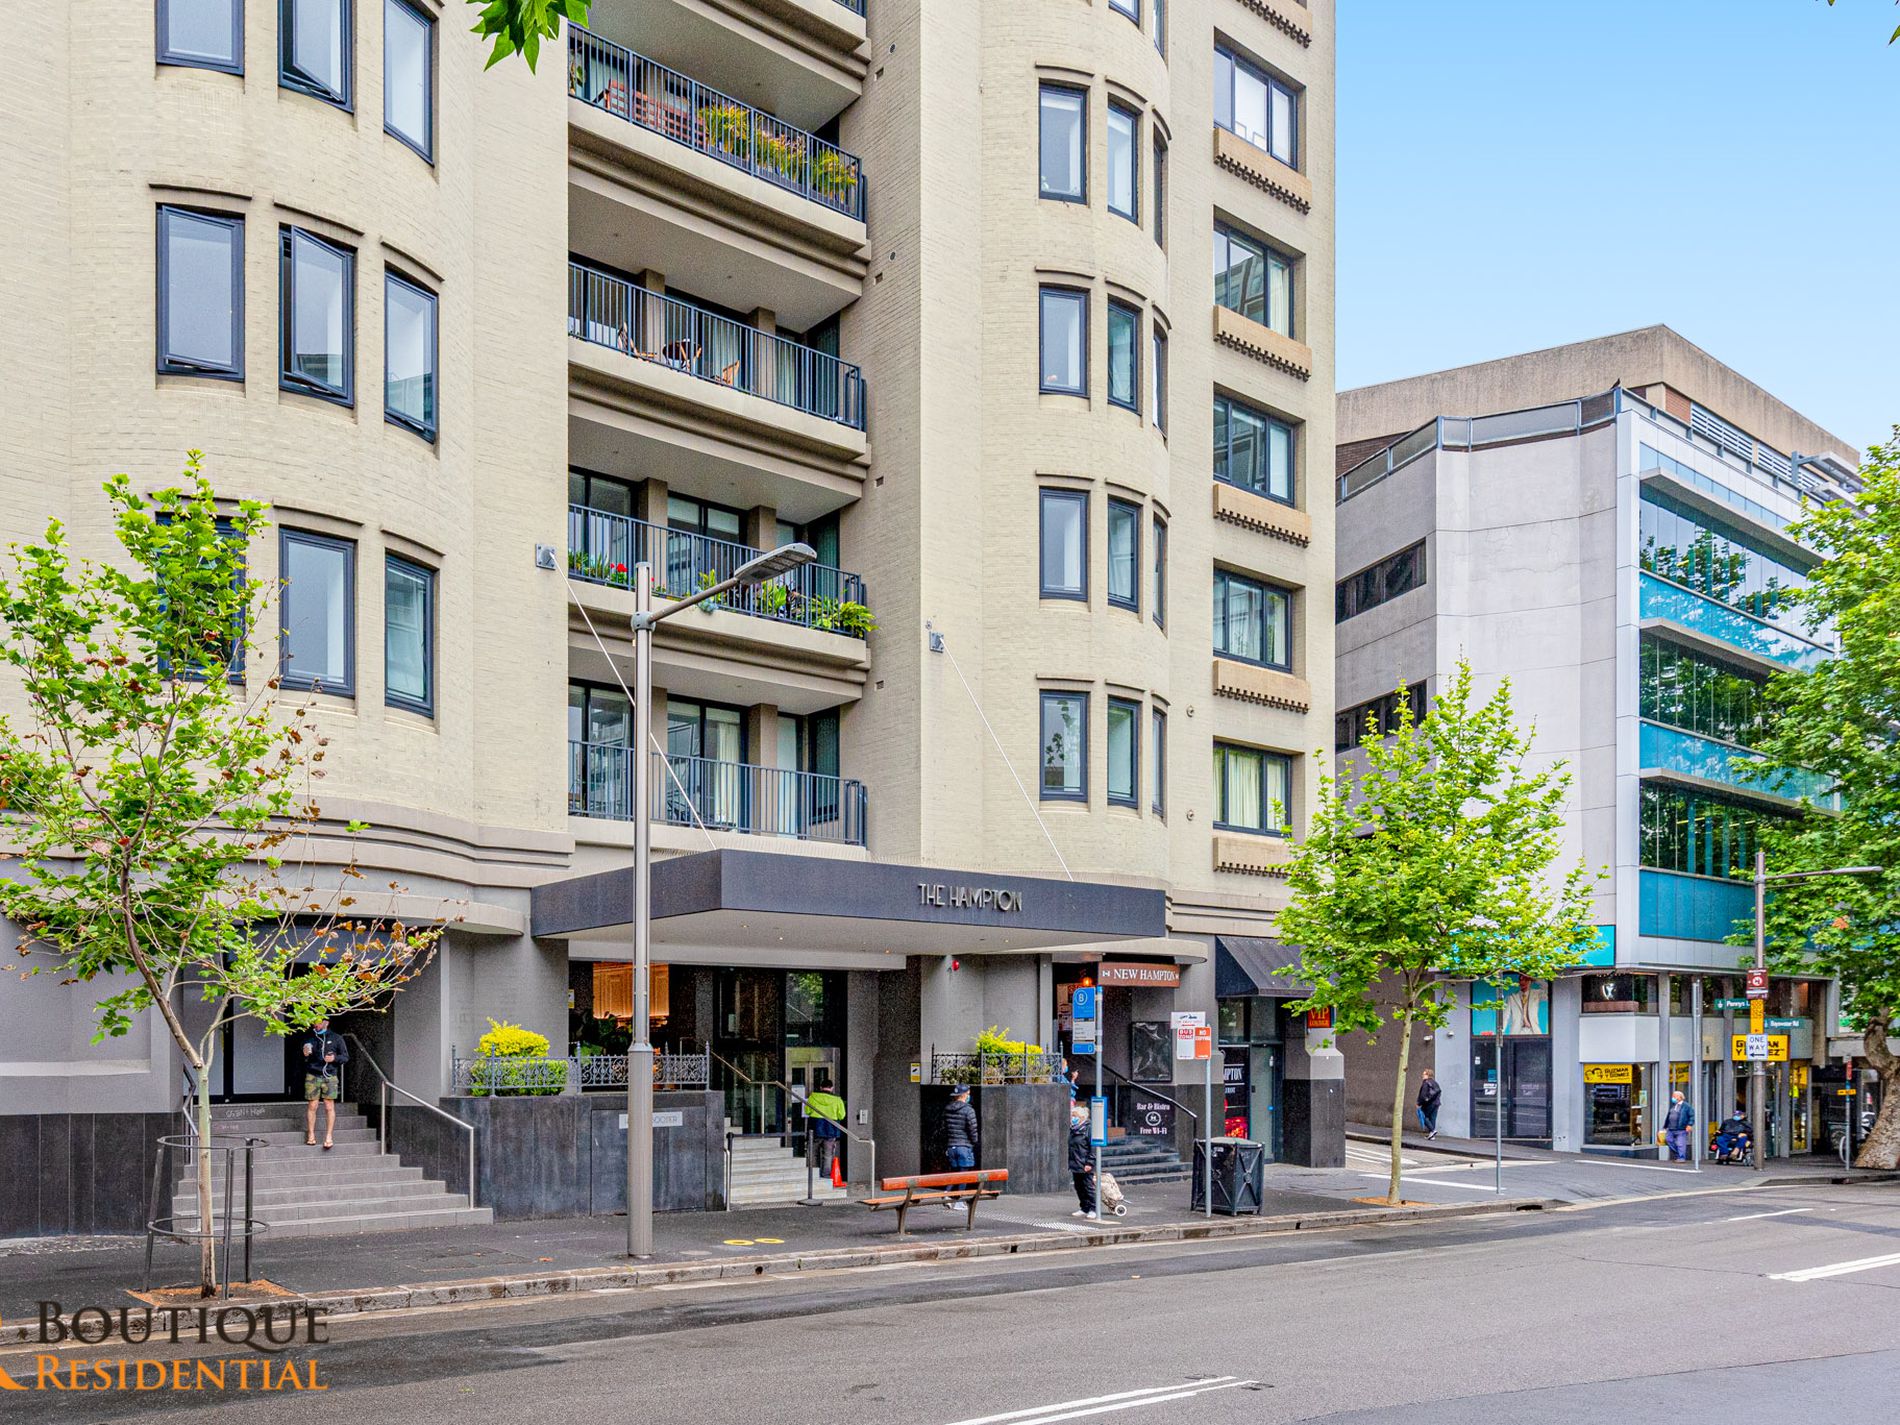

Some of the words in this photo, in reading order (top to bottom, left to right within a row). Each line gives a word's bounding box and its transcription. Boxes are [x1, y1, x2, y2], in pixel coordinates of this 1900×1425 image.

[918, 884, 945, 906] THE
[949, 886, 1022, 911] HAMPTON
[1114, 969, 1138, 980] NEW
[1140, 969, 1176, 981] HAMPTON
[1310, 1007, 1329, 1020] VIP
[1140, 1127, 1151, 1135] Free
